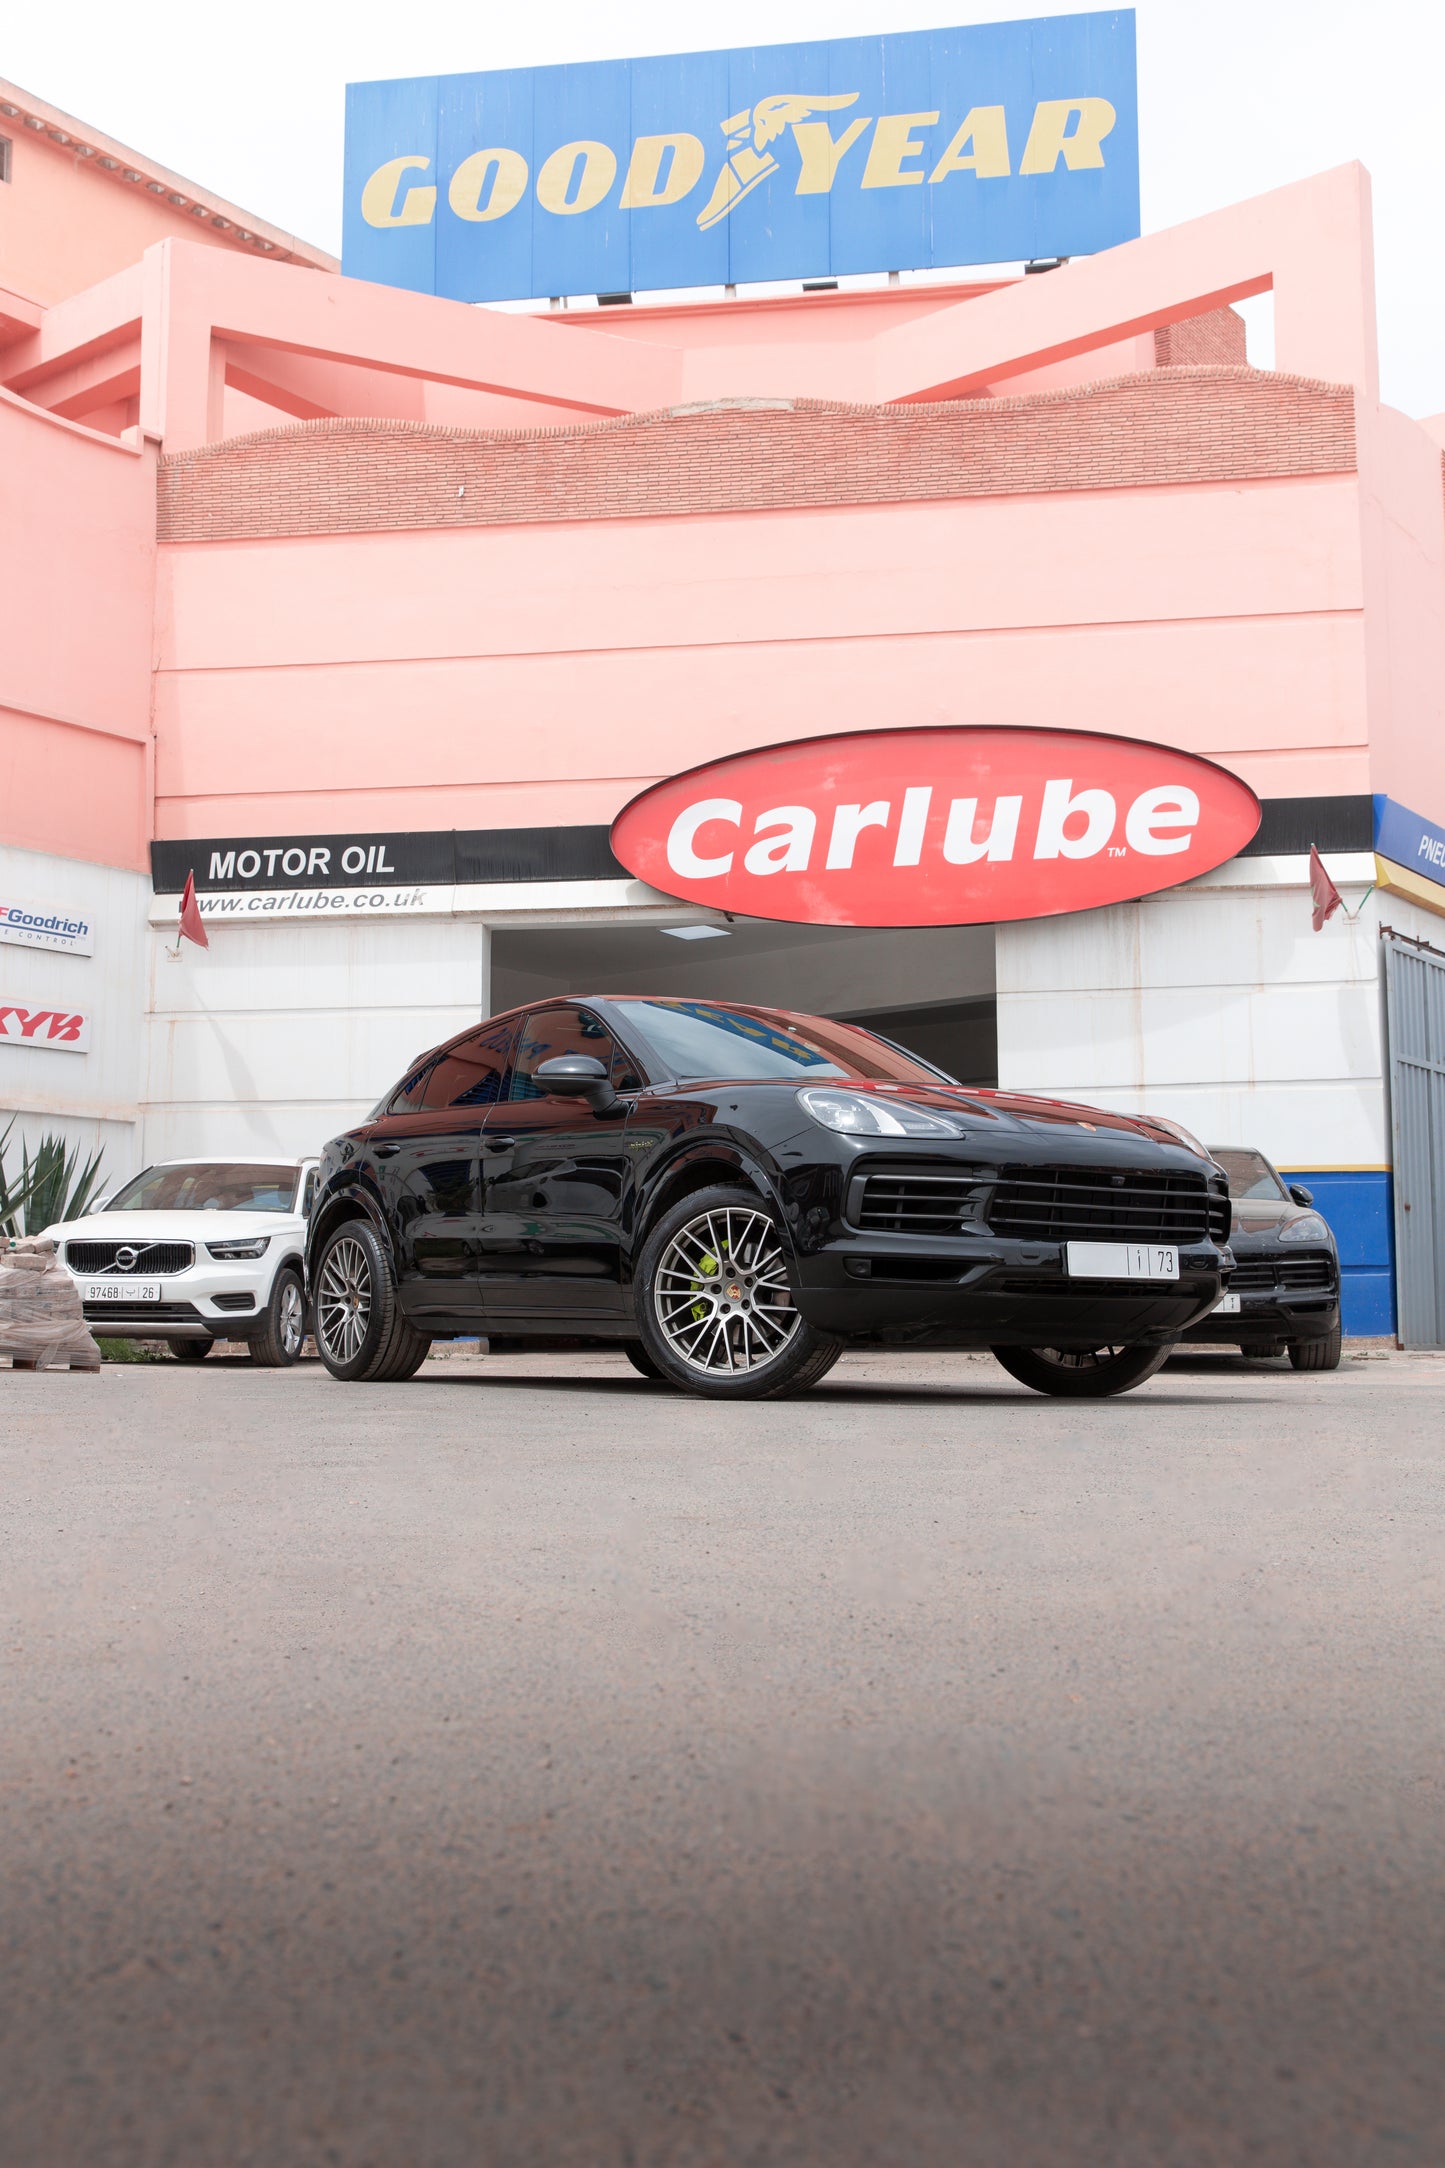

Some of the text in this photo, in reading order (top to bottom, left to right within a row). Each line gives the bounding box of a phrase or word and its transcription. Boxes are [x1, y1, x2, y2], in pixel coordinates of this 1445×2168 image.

[666, 779, 1200, 879] Carlube
[208, 845, 395, 879] MOTOR OIL
[178, 888, 427, 913] ww.carlube.co.uk
[1157, 1251, 1174, 1273] 73
[90, 1286, 119, 1299] 97468
[142, 1287, 154, 1299] 26
